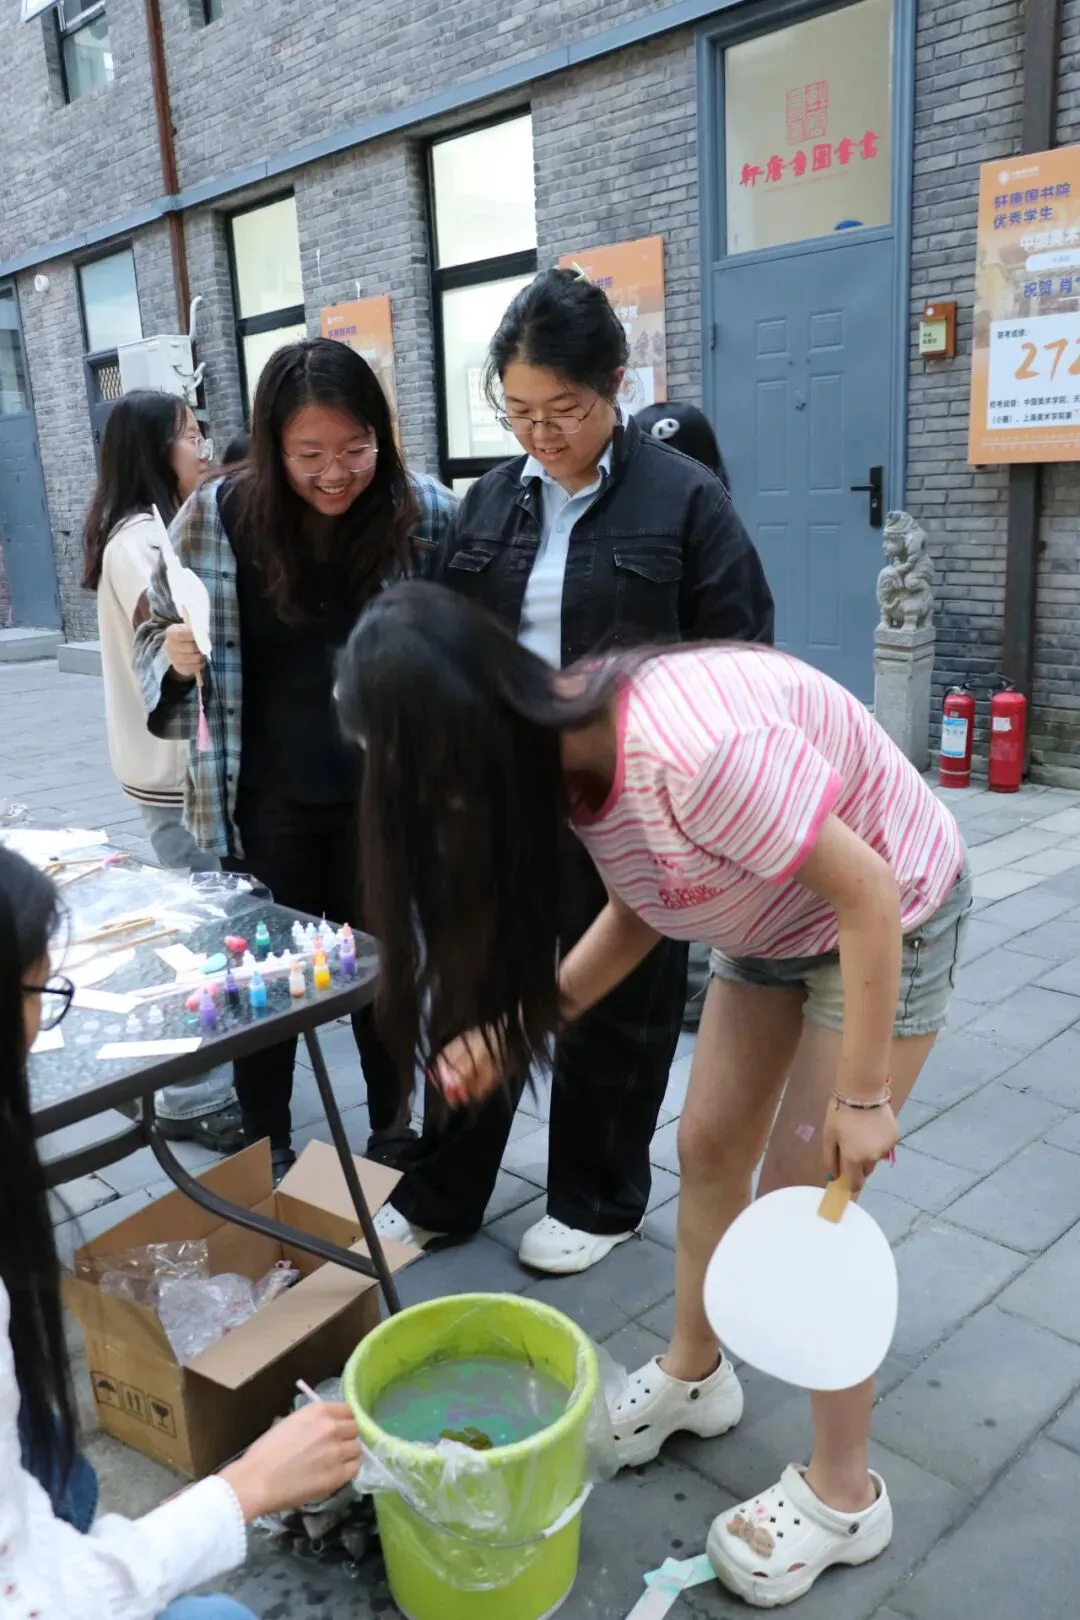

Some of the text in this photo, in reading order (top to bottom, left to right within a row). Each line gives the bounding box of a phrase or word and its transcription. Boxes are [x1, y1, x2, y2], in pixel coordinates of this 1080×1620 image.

[993, 206, 1053, 230] 优秀学生
[1023, 276, 1080, 298] 祝贺 肖
